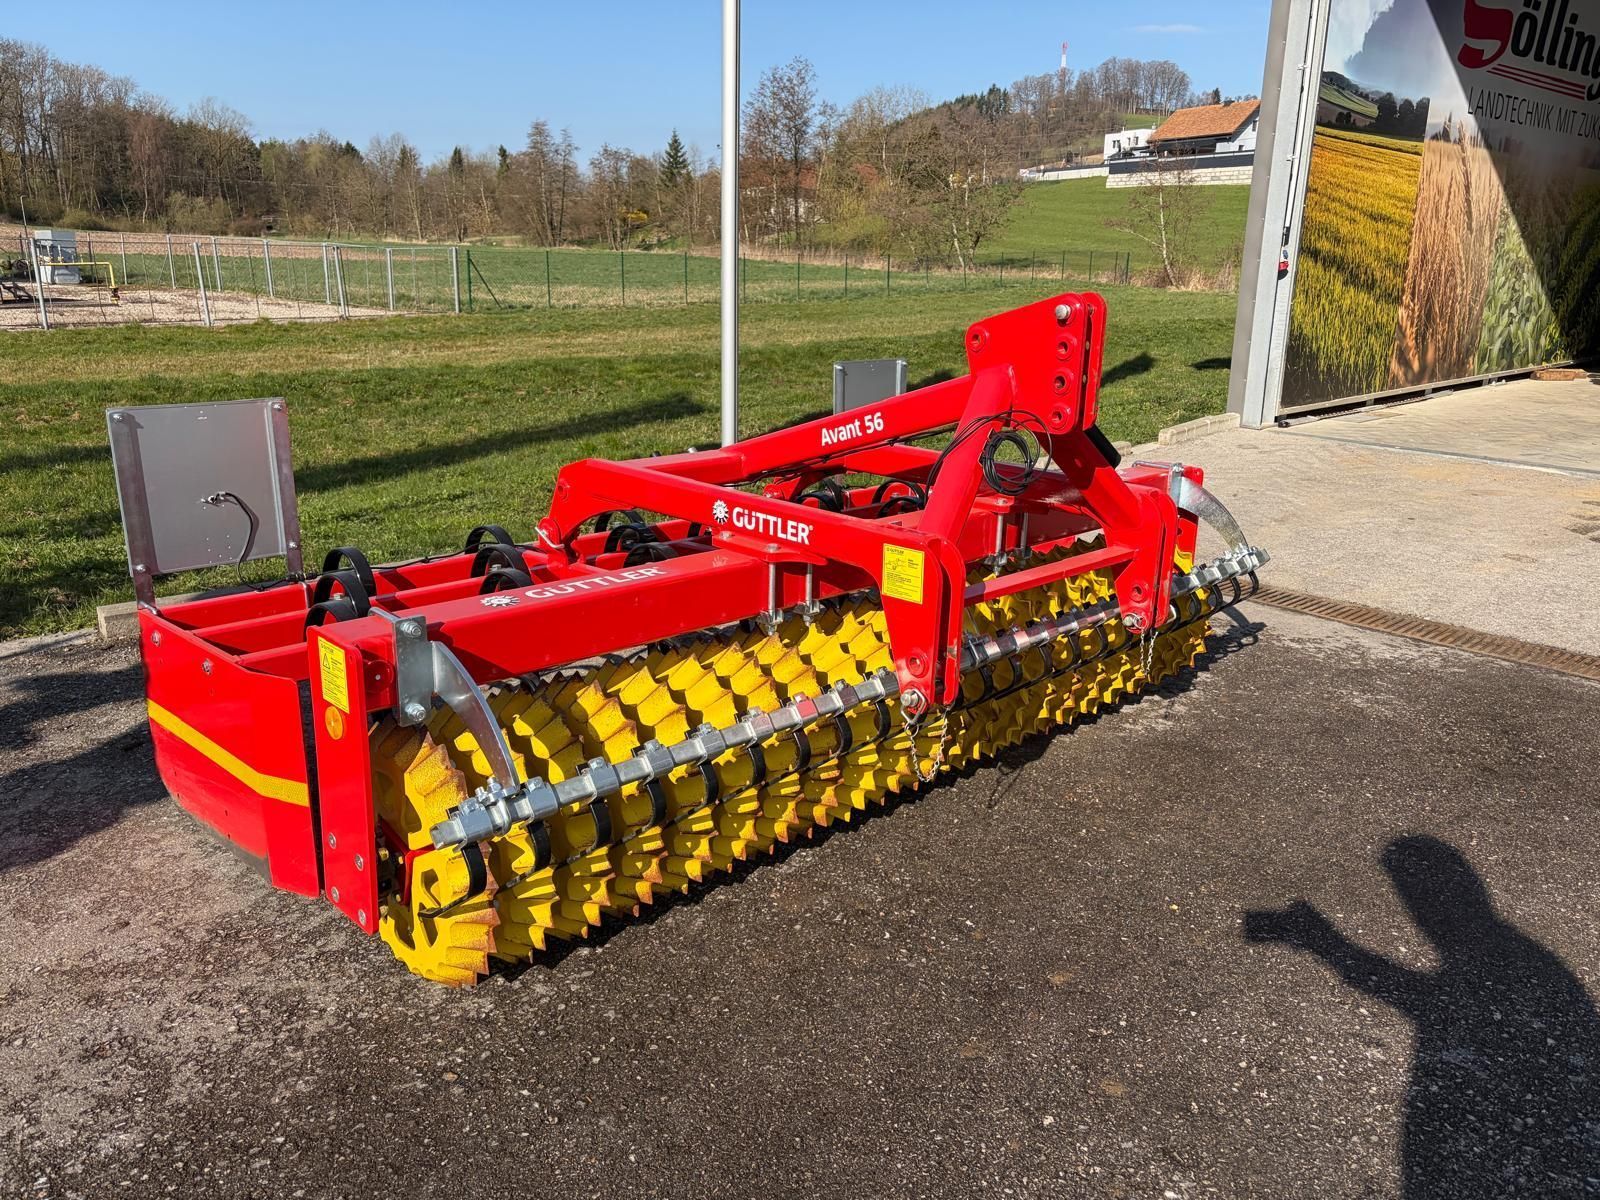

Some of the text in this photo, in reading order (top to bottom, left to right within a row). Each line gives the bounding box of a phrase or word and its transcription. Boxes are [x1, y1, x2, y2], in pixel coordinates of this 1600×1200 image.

[1467, 86, 1600, 141] LANDTECHNIK MIT ZUK
[820, 411, 884, 447] Avant 56
[732, 506, 811, 545] GÜTTLER
[524, 566, 667, 599] GÜTTLER
